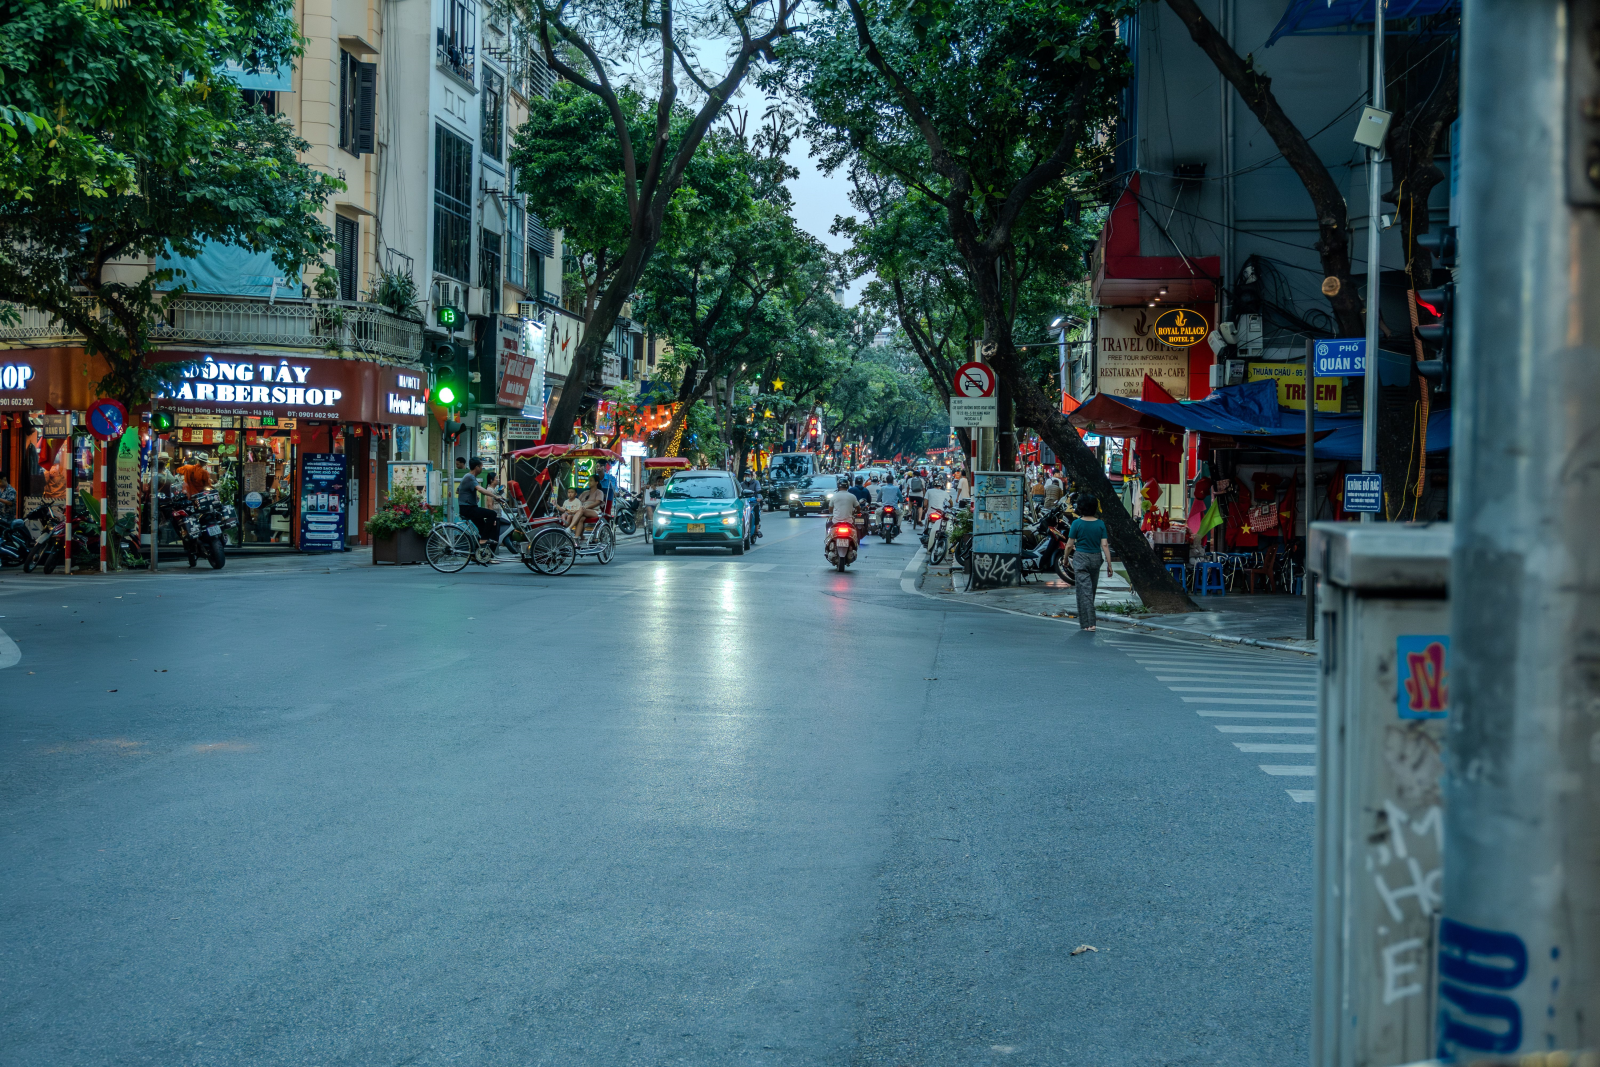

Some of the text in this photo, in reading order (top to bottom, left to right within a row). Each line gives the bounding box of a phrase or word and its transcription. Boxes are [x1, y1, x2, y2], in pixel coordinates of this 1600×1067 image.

[445, 311, 455, 322] 13
[1158, 327, 1204, 335] ROYAL PALACE
[1102, 338, 1184, 352] TRAVEL OFF
[1339, 342, 1359, 352] PHỐ
[1320, 355, 1350, 370] QUÁN
[259, 360, 311, 383] TÂY
[1100, 368, 1144, 377] RESTAURANT
[1149, 368, 1163, 377] BAR
[1168, 368, 1185, 377] CAFE
[1253, 367, 1273, 378] THUẬN
[1274, 367, 1291, 376] CHÂU
[0, 366, 34, 390] OP
[1316, 384, 1337, 401] EM
